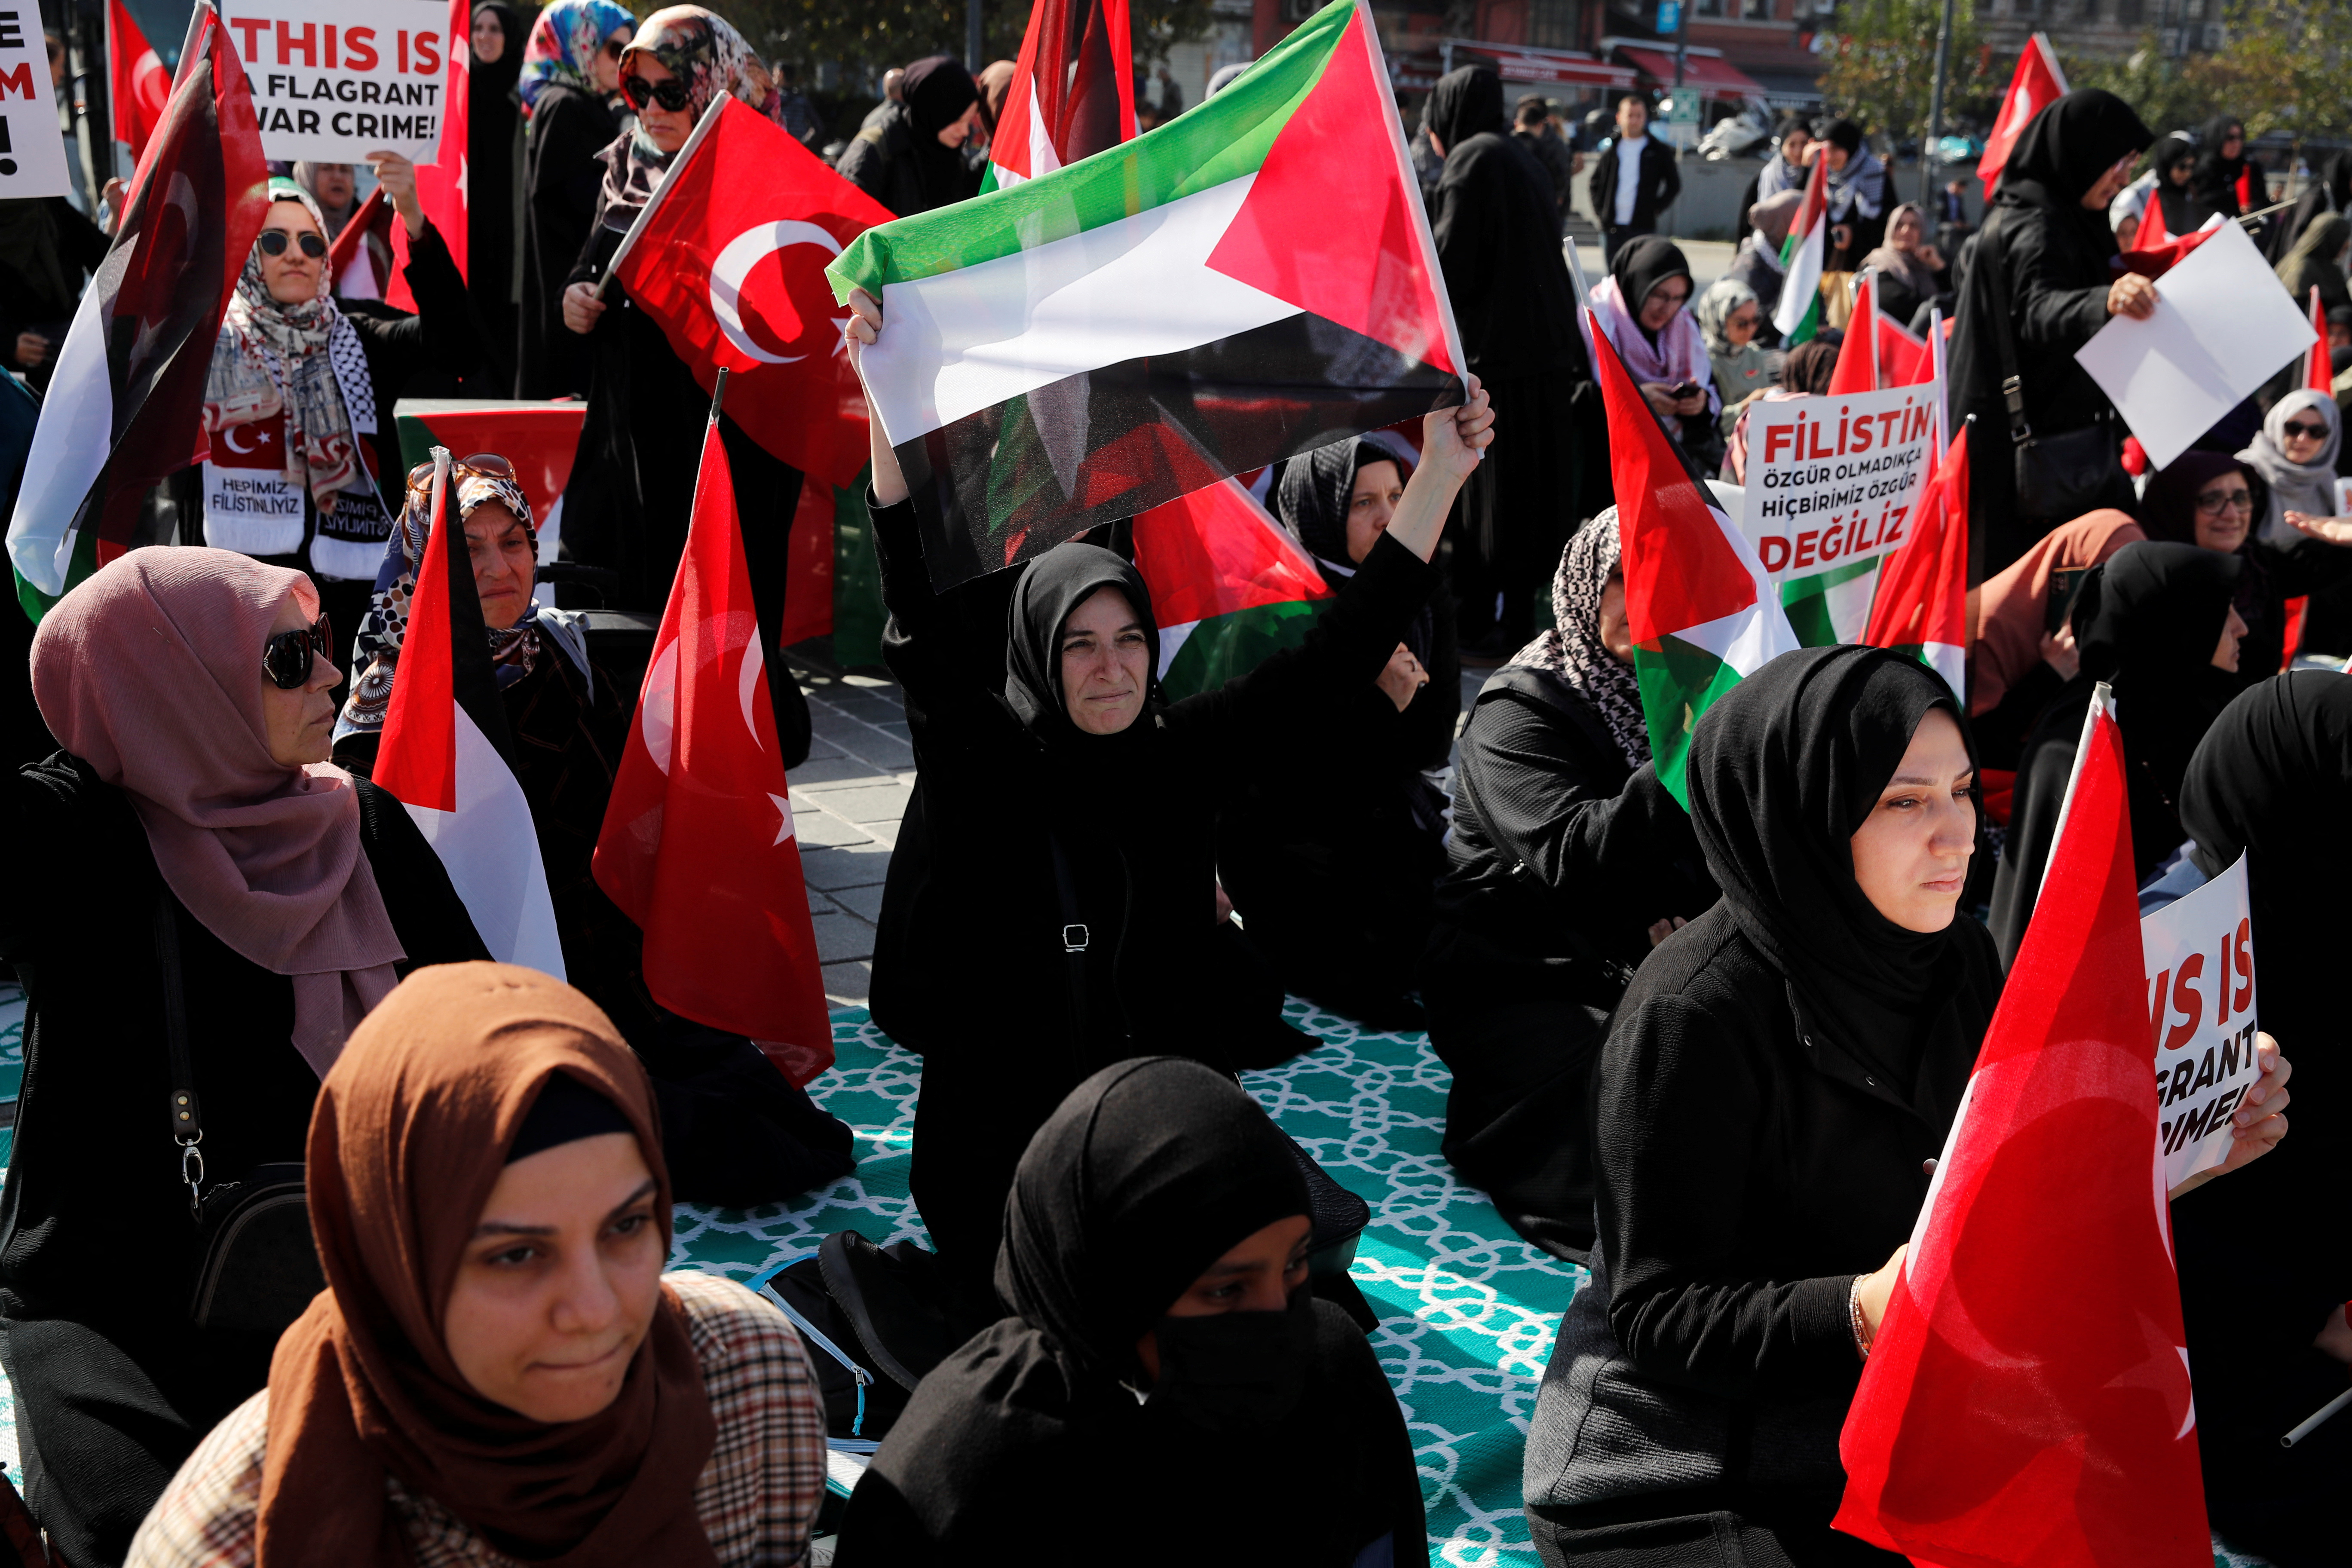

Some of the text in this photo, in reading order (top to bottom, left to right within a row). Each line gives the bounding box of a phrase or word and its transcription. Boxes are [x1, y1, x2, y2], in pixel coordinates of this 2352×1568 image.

[231, 18, 441, 76] THIS IS
[269, 75, 439, 106] FLAGRANT
[332, 112, 436, 139] CRIME!
[1764, 396, 1932, 463] FİLİSTİN
[1762, 470, 1917, 520] HİÇBİRİMİZ ÖZGÜR
[1764, 447, 1922, 488] ÖZGÜR OLMADIKÇA
[1759, 501, 1908, 573] DEĞİLİZ
[2146, 917, 2252, 1059] IS IS
[2156, 1019, 2255, 1108] GRANT
